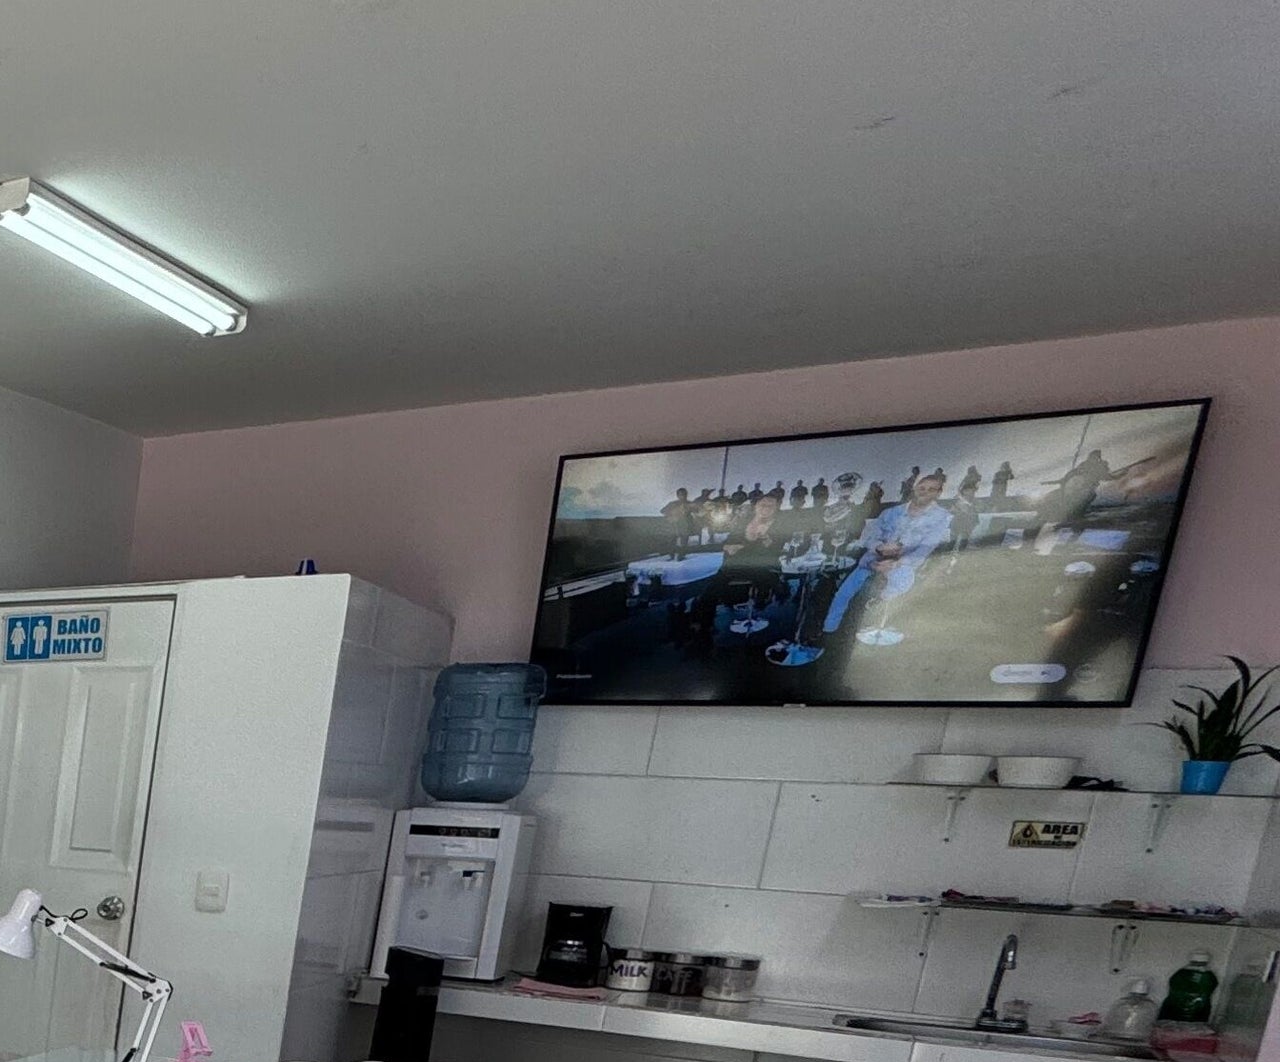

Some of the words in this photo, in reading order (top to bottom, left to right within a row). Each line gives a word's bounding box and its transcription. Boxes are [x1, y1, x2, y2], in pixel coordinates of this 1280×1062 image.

[57, 615, 101, 635] BAÑO
[52, 637, 103, 655] MIXTO
[1041, 824, 1078, 835] AREA
[609, 963, 648, 979] MILK
